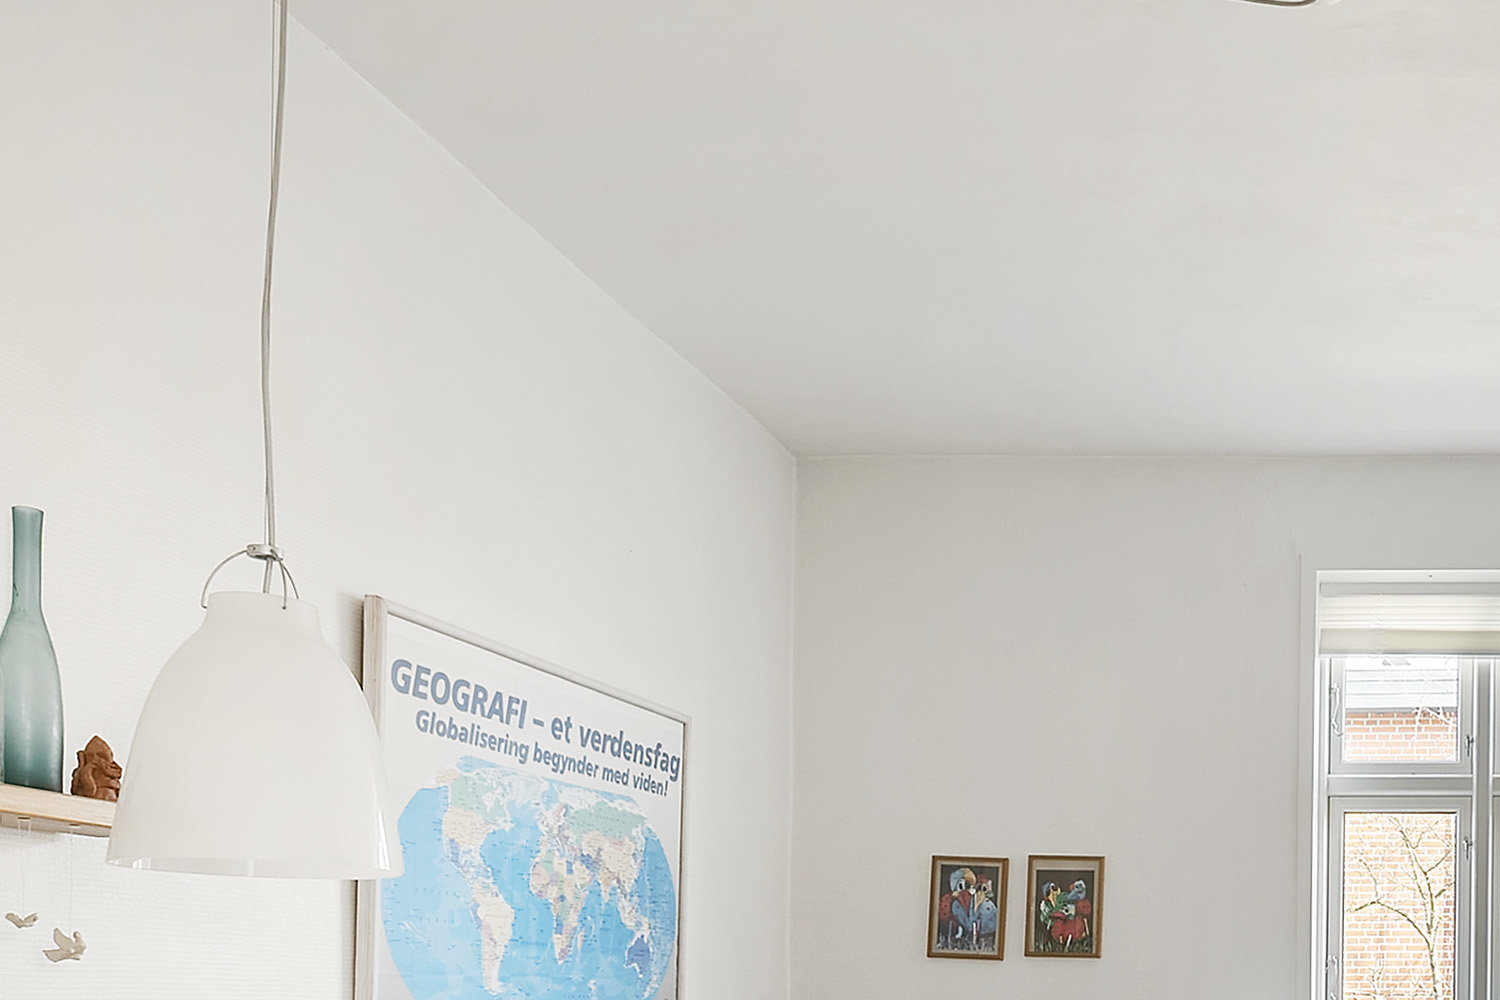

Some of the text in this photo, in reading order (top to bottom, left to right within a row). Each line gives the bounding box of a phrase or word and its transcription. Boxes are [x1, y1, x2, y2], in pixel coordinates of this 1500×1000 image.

[391, 659, 528, 729] GEOGRAFI
[550, 715, 573, 744] et
[579, 724, 681, 782] verdensfag
[416, 710, 669, 797] Globalisering begynder med viden!
